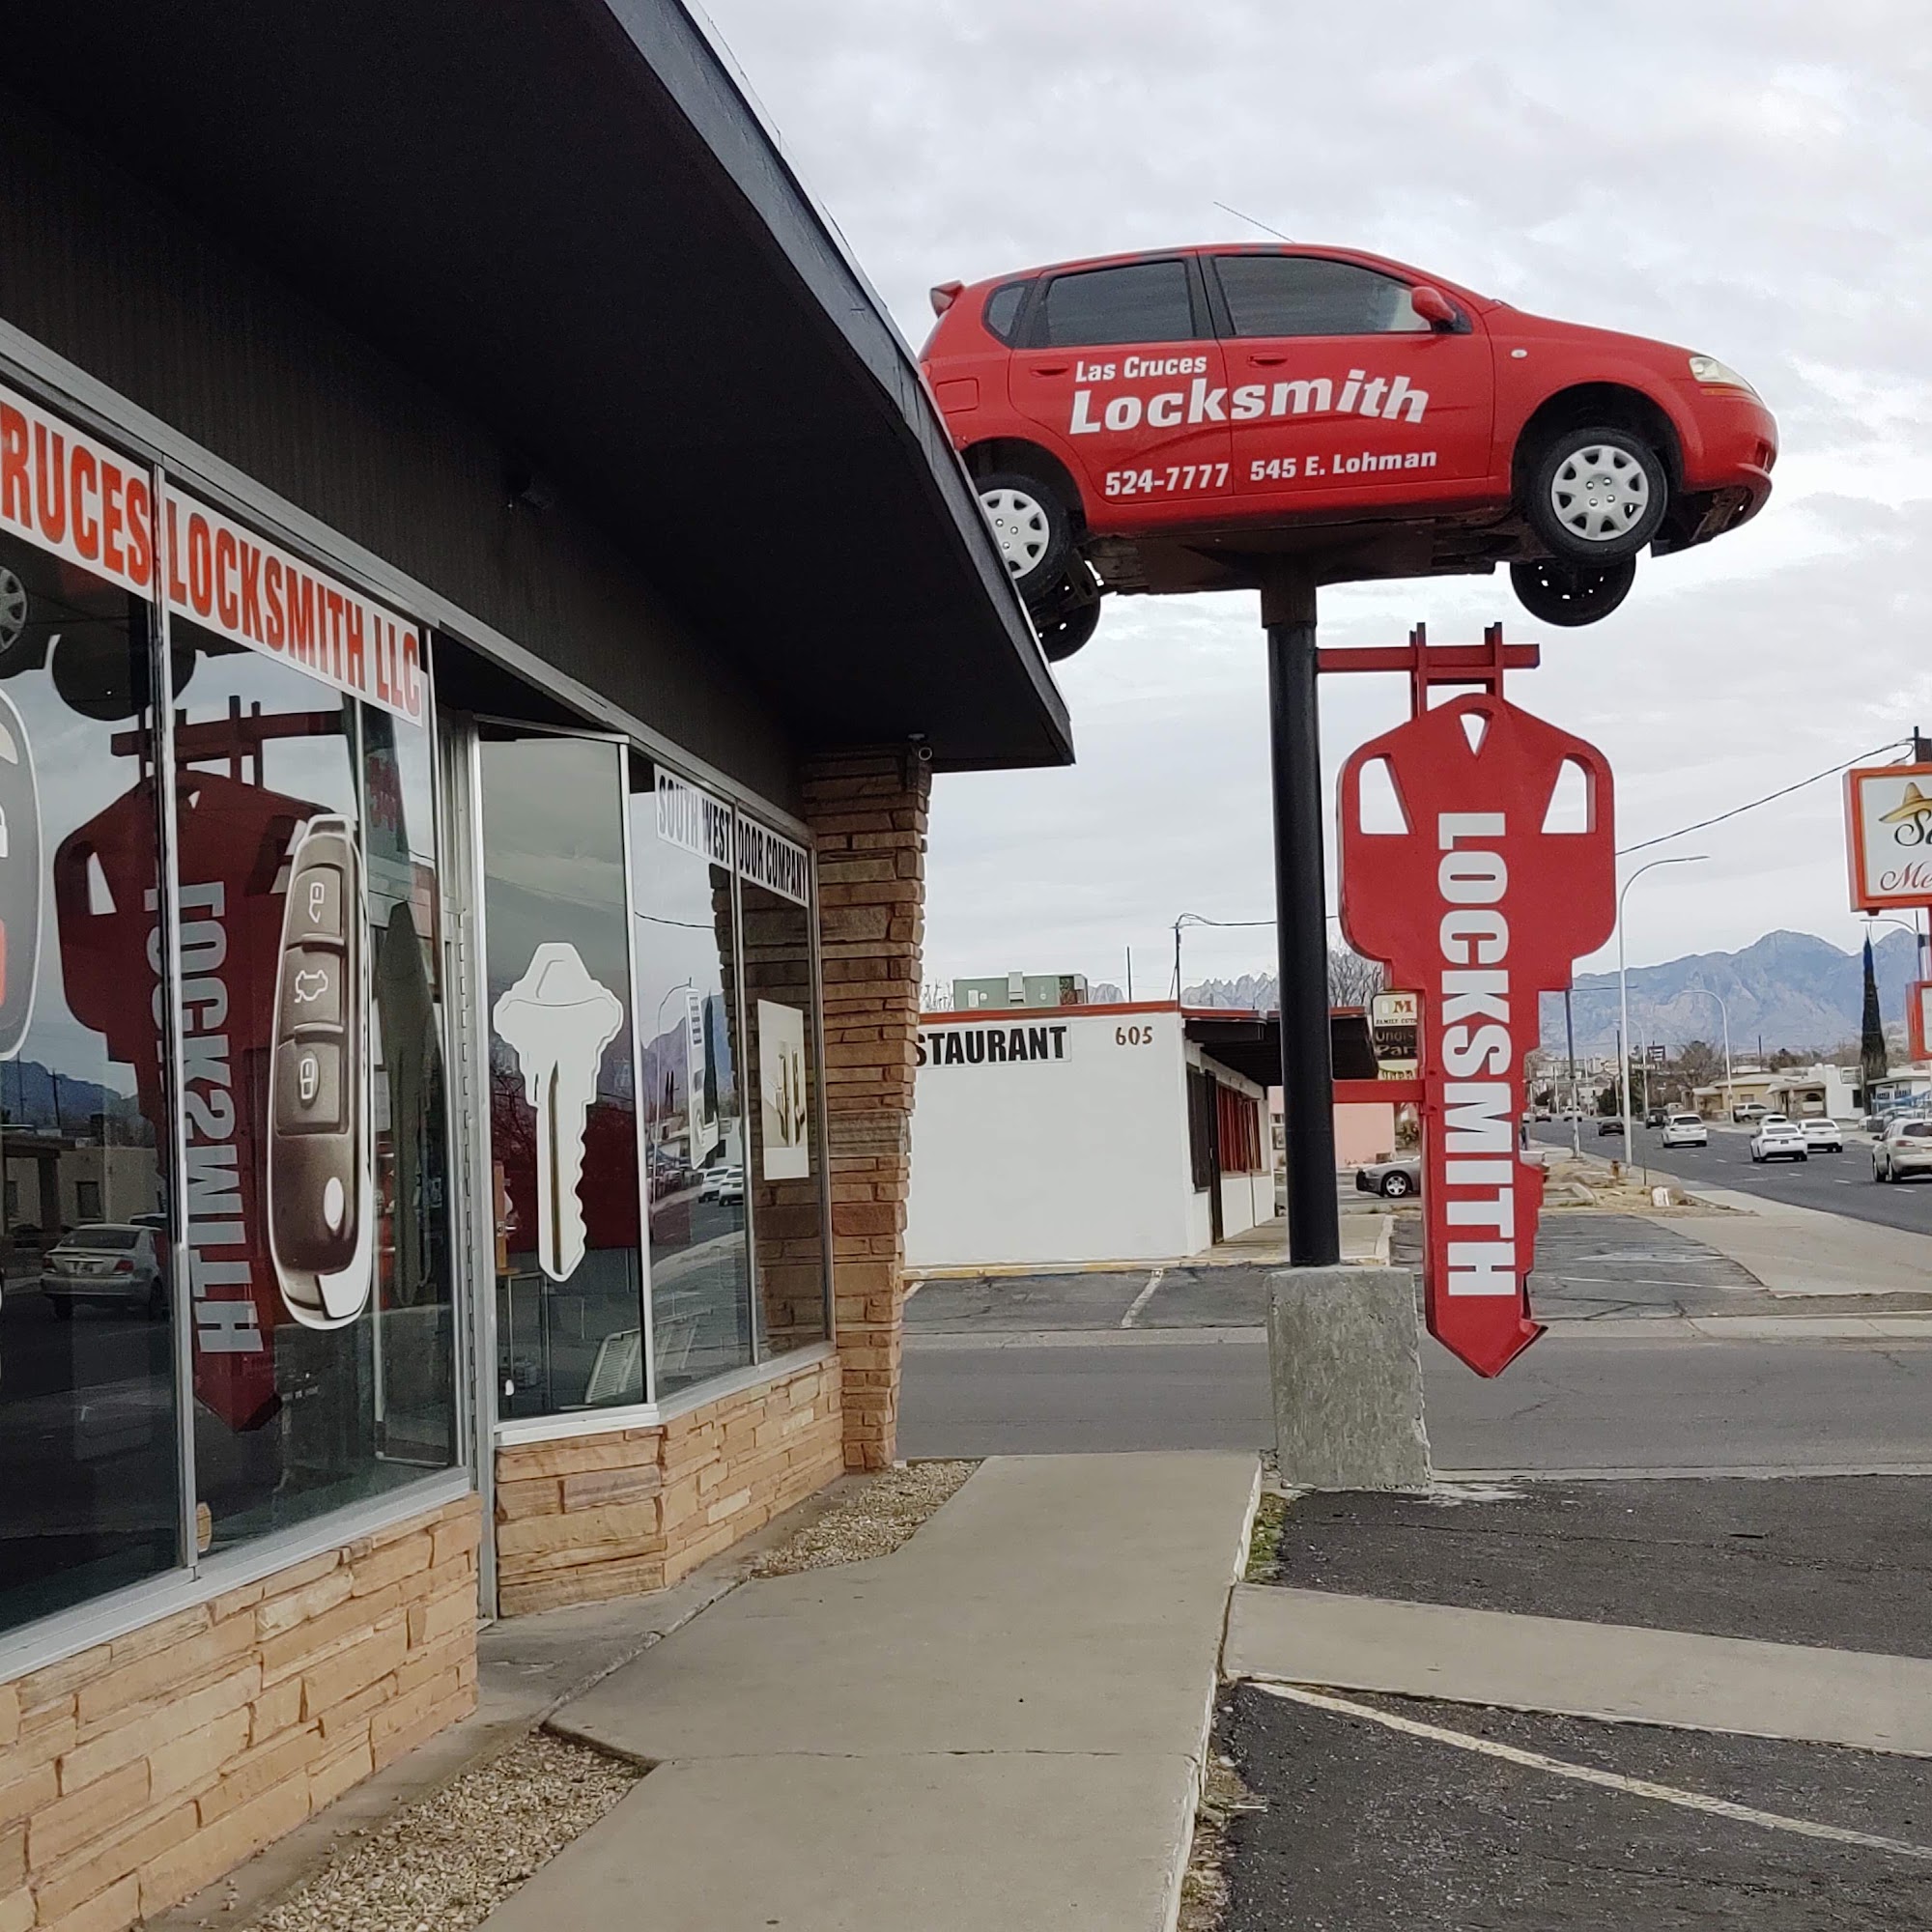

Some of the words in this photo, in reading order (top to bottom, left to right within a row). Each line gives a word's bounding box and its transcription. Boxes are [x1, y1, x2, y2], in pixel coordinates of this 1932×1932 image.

[1075, 360, 1116, 383] Las
[1123, 356, 1208, 380] Cruces
[1069, 369, 1430, 436] Locksmith
[1105, 463, 1230, 497] 524-7777
[1250, 458, 1296, 482] 545
[1305, 456, 1325, 477] E.
[1332, 451, 1437, 475] Lohman
[0, 399, 152, 587] RUCES
[166, 497, 367, 693] LOCKSMITH
[373, 614, 421, 718] LLC
[659, 775, 698, 850] SOUTH
[701, 797, 731, 865] WEST
[738, 818, 764, 881] DOOR
[766, 834, 808, 902] COMPANY
[1115, 1026, 1152, 1046] 605
[1437, 812, 1517, 1296] LOCKSMITH
